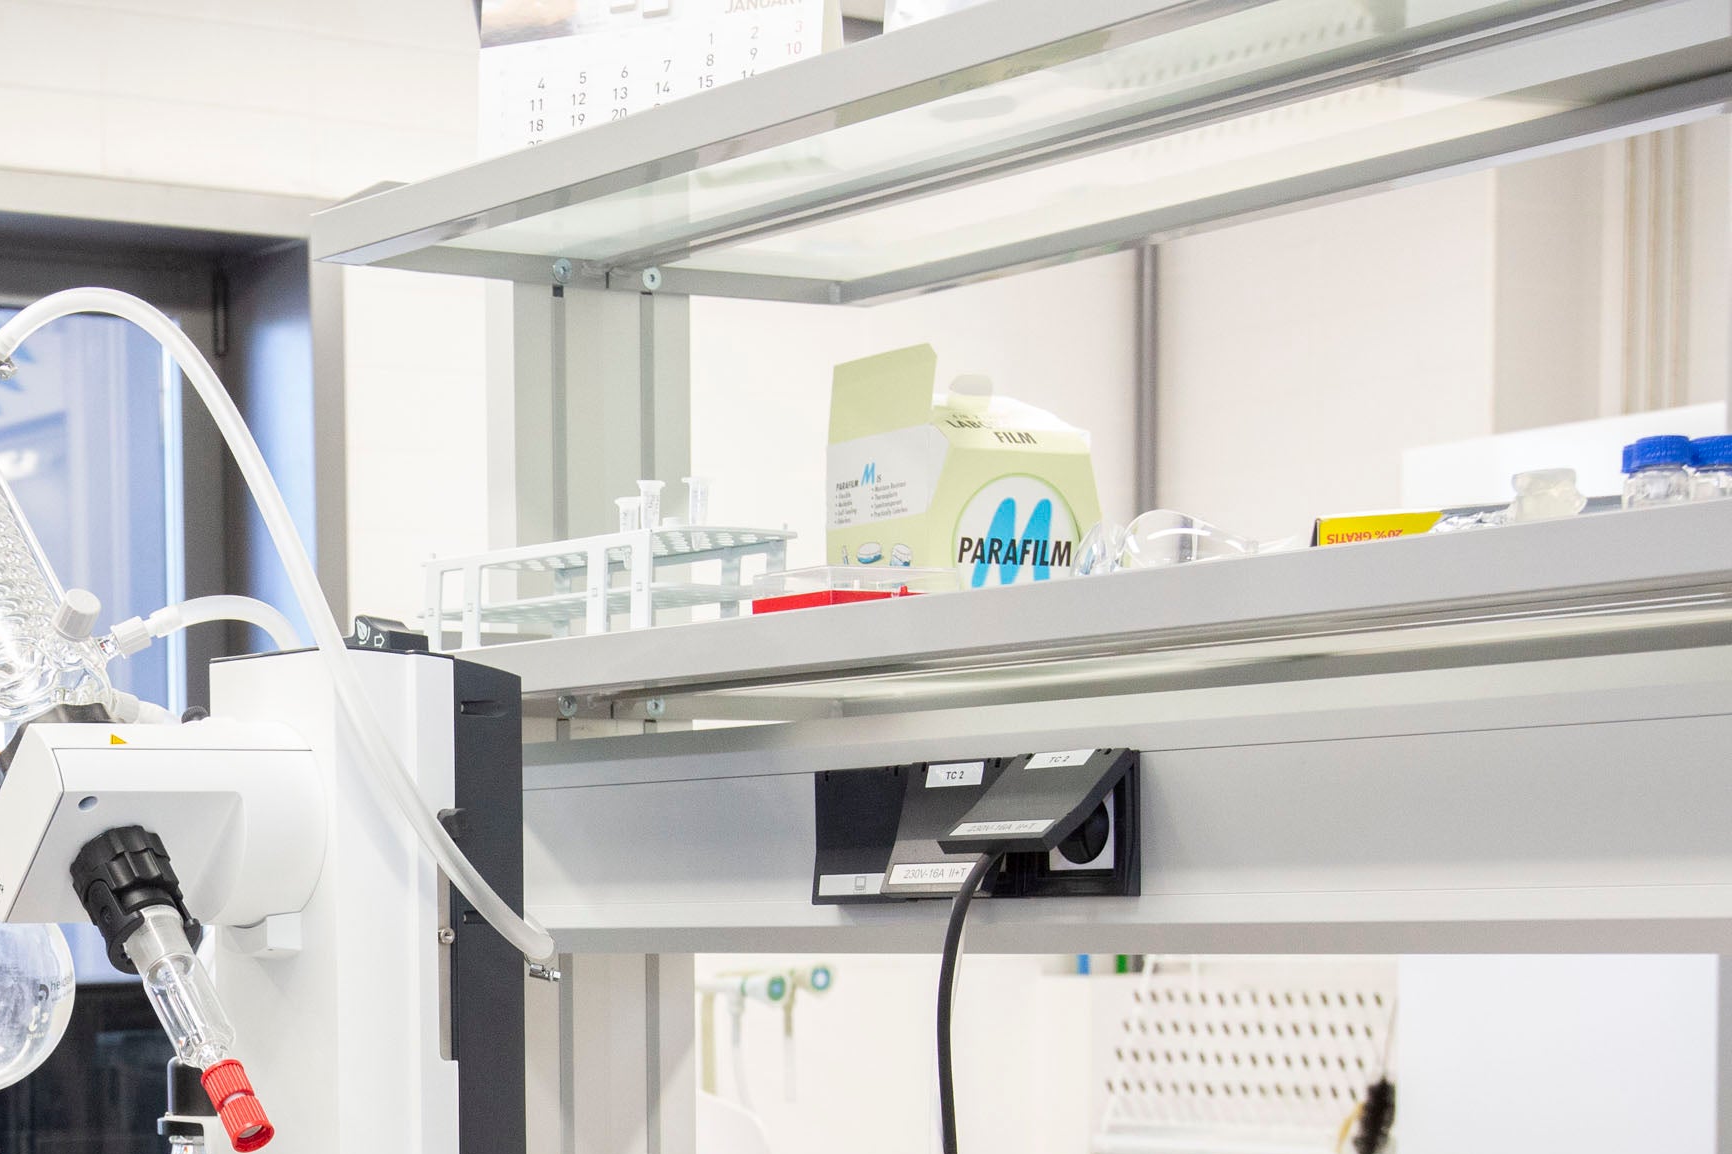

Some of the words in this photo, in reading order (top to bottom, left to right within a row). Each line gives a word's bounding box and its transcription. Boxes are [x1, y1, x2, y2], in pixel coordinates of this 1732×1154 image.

[709, 32, 714, 46] 1
[750, 26, 759, 40] 2
[795, 20, 803, 33] 3
[537, 77, 545, 90] 4
[579, 71, 587, 85] 5
[620, 65, 629, 79] 6
[663, 59, 671, 73] 7
[706, 53, 714, 67] 8
[749, 47, 758, 61] 9
[785, 41, 803, 55] 10
[530, 98, 543, 112] 11
[571, 92, 586, 106] 12
[613, 87, 628, 101] 13
[655, 82, 670, 95] 14
[698, 75, 714, 89] 15
[529, 119, 544, 132] 18
[571, 113, 586, 127] 19
[994, 431, 1038, 444] FILM
[860, 461, 875, 487] M
[1327, 531, 1372, 545] GRATIS
[957, 536, 1072, 567] PARAFILM
[1063, 755, 1070, 763] 2
[946, 771, 957, 780] TC
[958, 770, 965, 779] 2
[903, 868, 945, 879] 230V-16A
